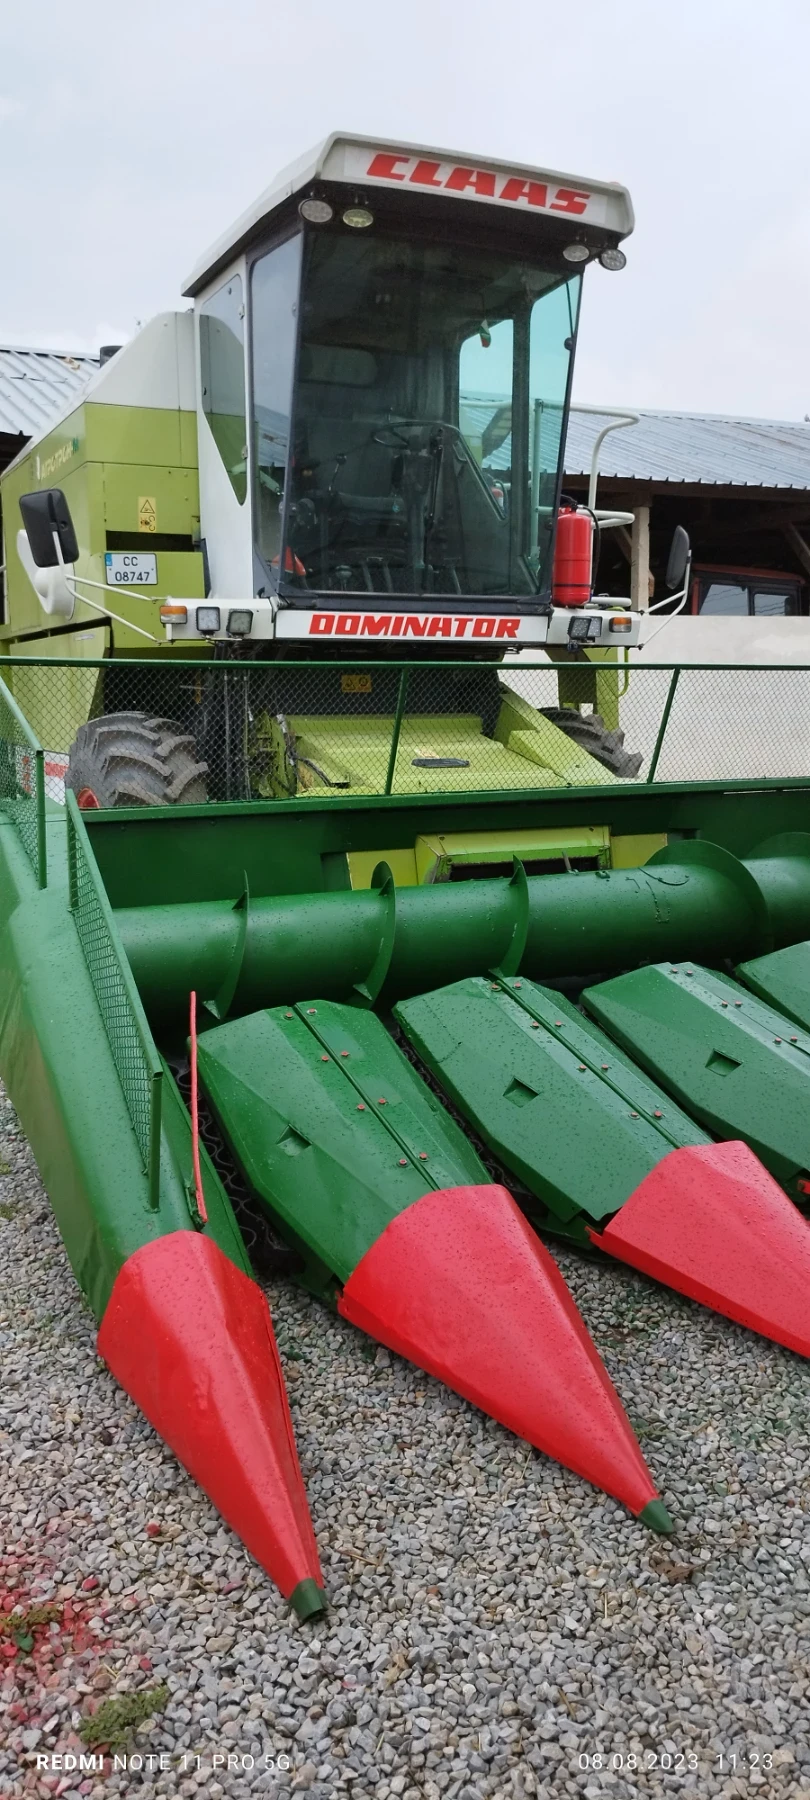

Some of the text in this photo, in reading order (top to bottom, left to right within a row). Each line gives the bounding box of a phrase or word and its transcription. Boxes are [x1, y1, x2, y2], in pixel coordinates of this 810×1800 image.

[366, 153, 591, 215] CLAAS
[115, 571, 150, 582] 08747
[309, 614, 521, 638] DOMINATOR
